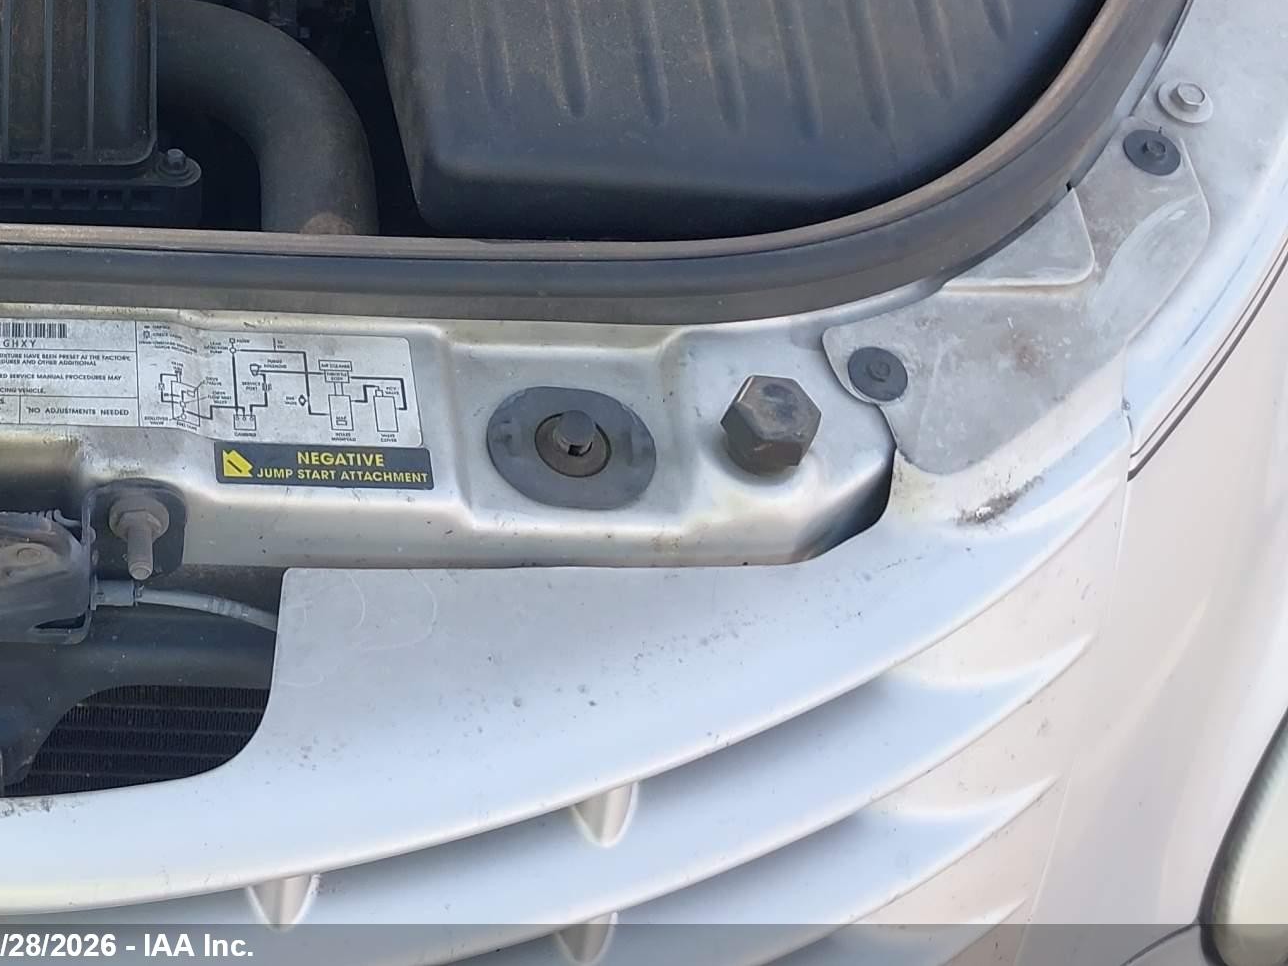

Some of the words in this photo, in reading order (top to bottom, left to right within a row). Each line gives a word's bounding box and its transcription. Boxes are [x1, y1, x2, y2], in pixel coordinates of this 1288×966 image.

[297, 451, 385, 467] NEGATIVE
[256, 469, 292, 478] JUMP
[297, 471, 336, 480] START
[340, 472, 428, 482] ATTACHMENT
